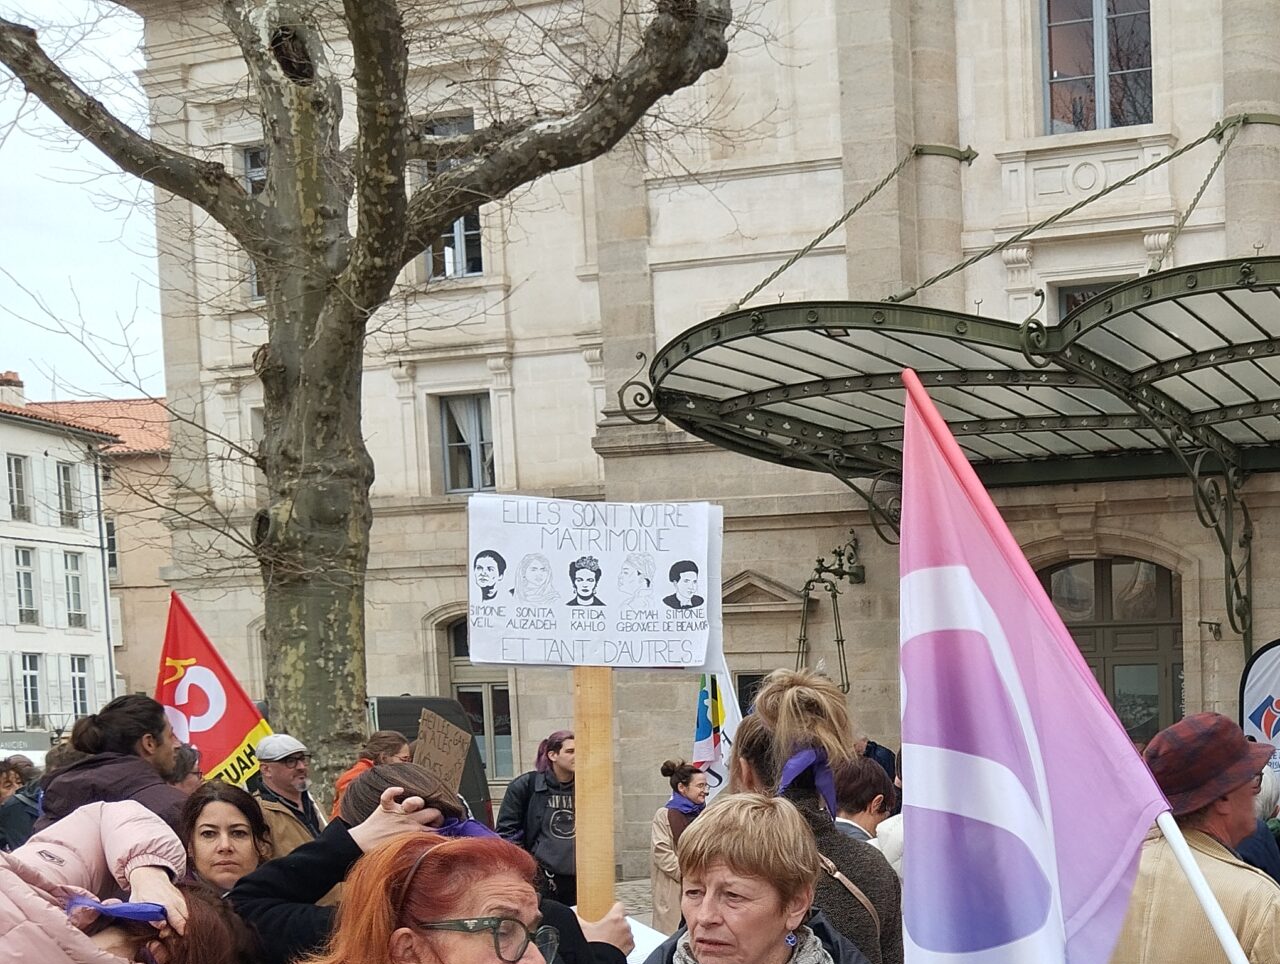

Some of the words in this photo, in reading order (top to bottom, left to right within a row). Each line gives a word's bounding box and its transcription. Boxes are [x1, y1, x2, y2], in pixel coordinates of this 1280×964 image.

[503, 500, 560, 525] ELLES
[572, 503, 624, 528] SONT
[630, 504, 689, 528] NOTRE
[541, 527, 670, 552] MATRIMOINE
[516, 607, 555, 618] SONITA
[572, 609, 606, 619] FRIDA
[620, 610, 658, 620] LEYMAH
[666, 609, 704, 619] SIMONE
[471, 617, 494, 628] VEIL
[506, 619, 557, 630] ALIZADEH
[570, 621, 606, 632] KAHLO
[616, 621, 660, 632] GBOWEE
[662, 622, 674, 632] DE
[502, 638, 530, 661] ET
[537, 638, 591, 662] TANT
